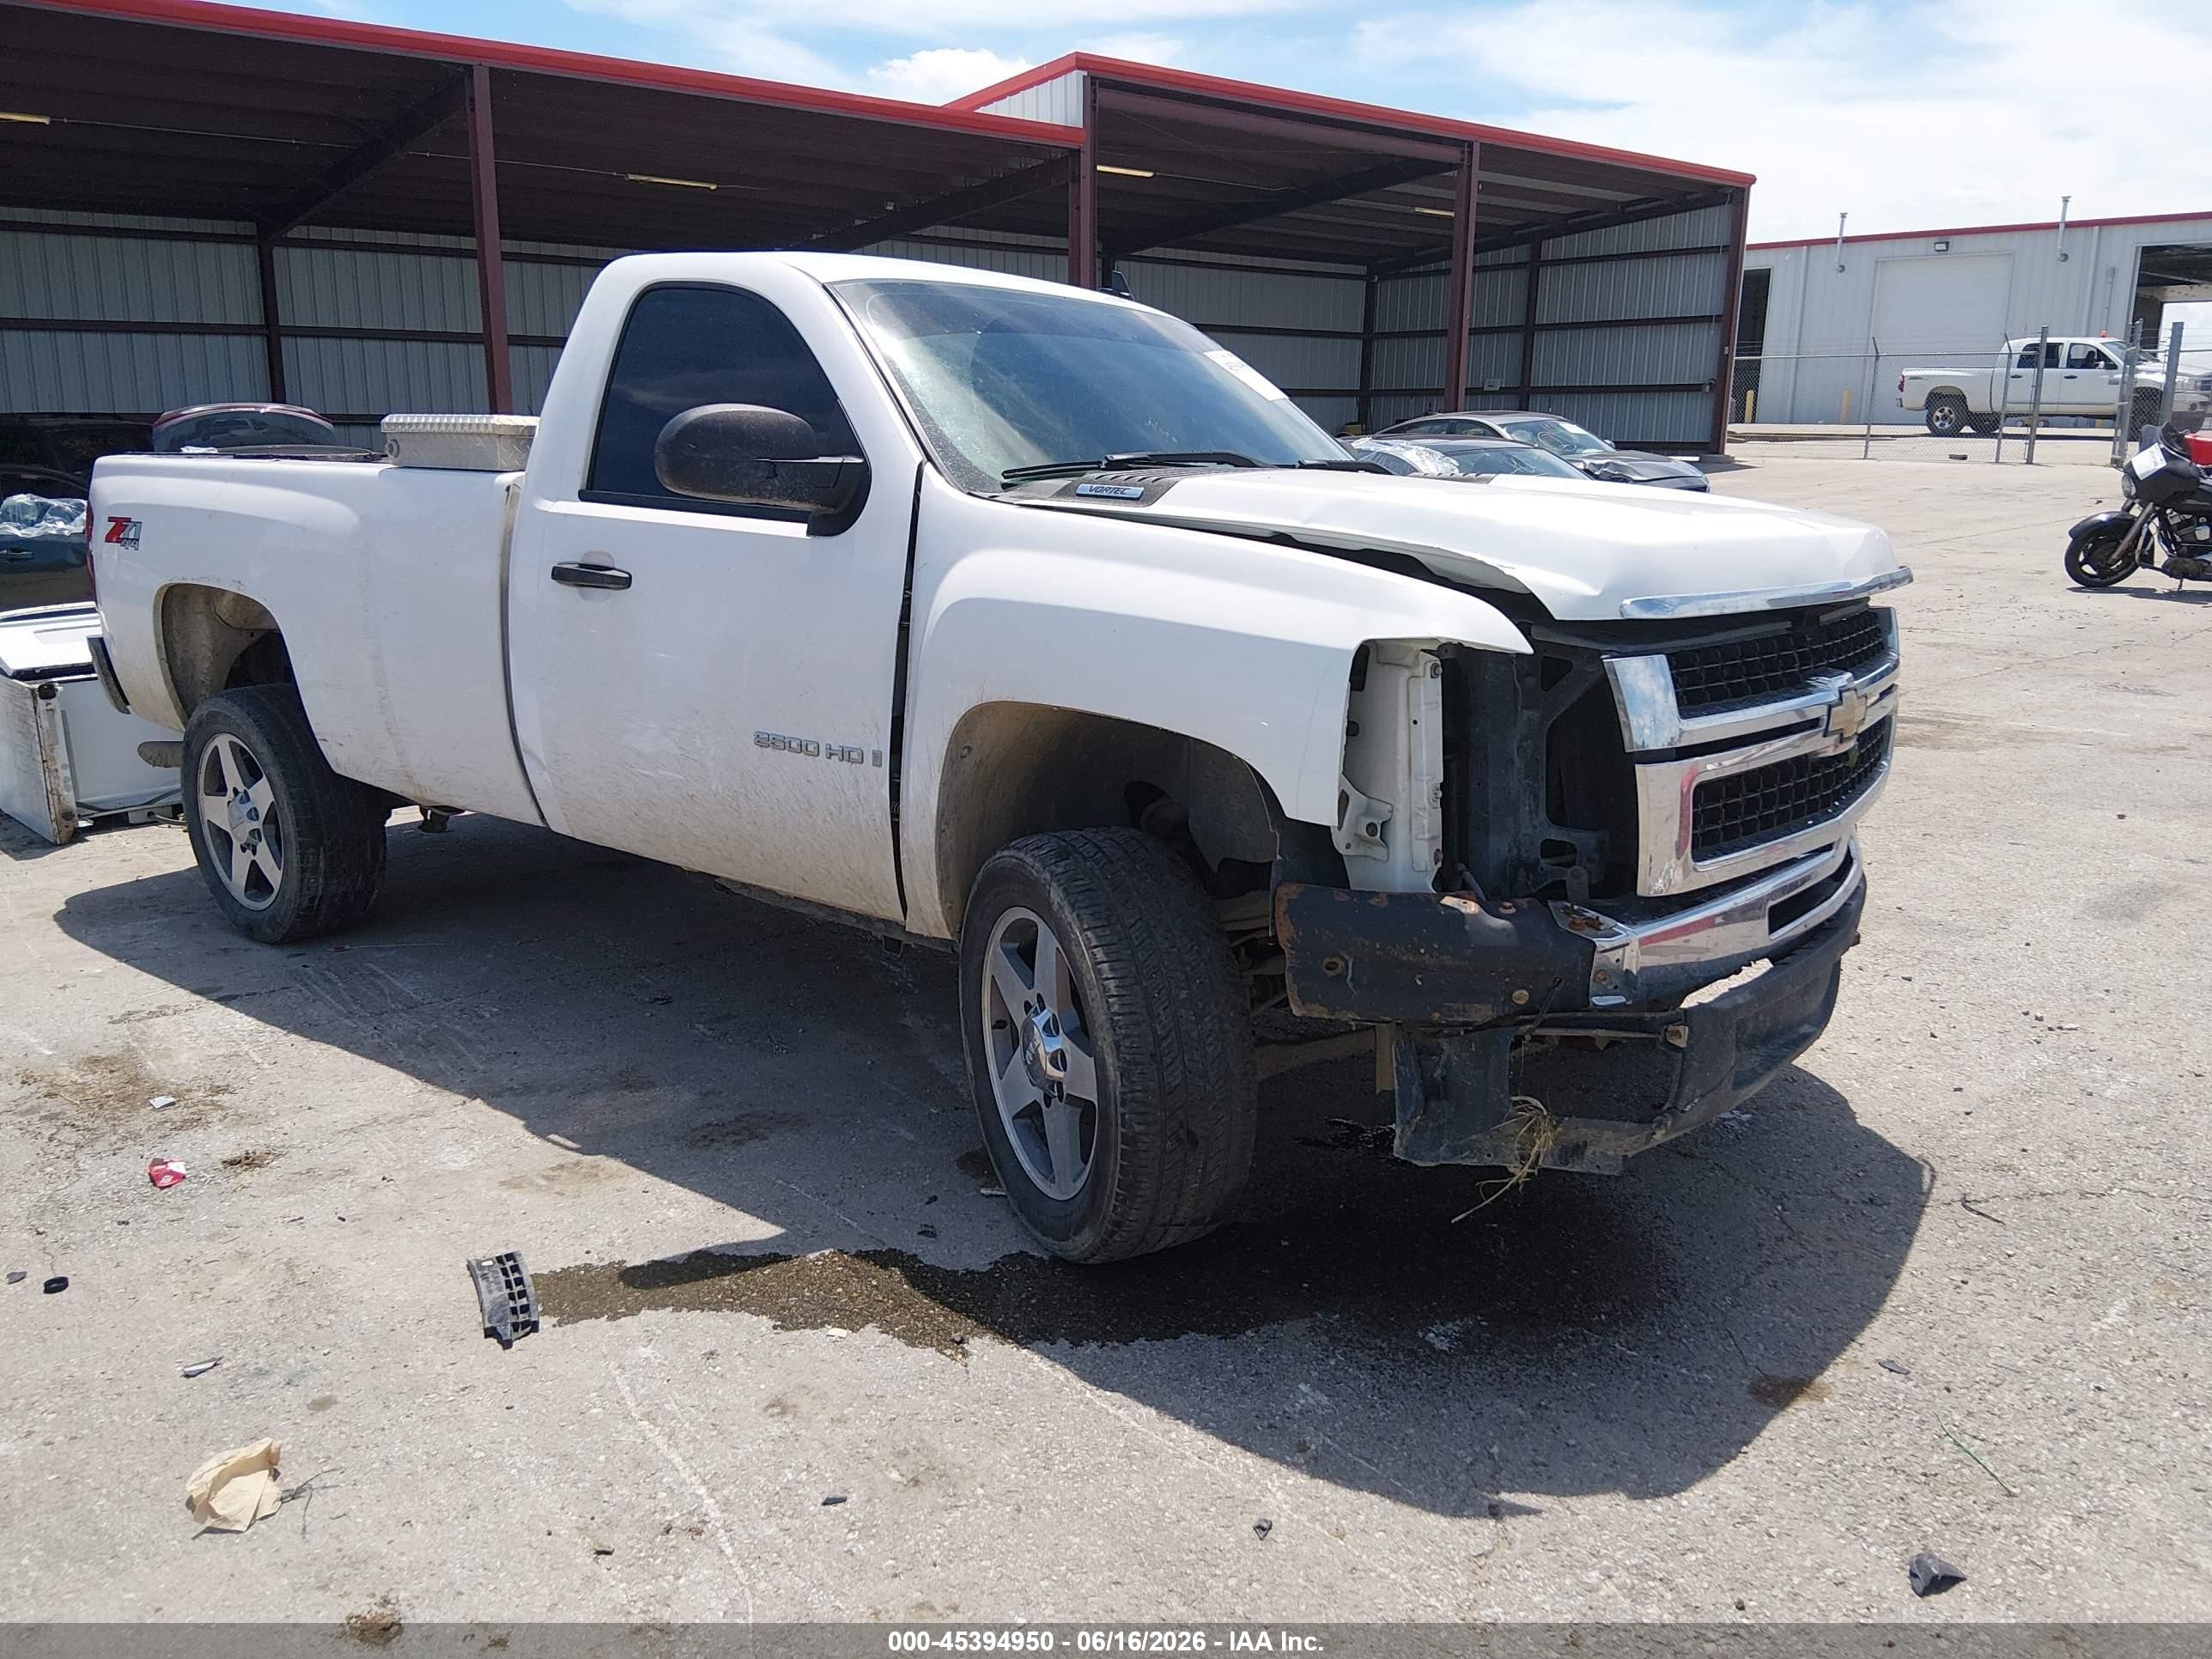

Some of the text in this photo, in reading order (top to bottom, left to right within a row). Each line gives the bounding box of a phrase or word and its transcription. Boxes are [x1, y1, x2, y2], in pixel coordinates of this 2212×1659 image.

[1089, 485, 1131, 495] VORTEC
[105, 516, 143, 544] Z71
[754, 731, 864, 764] 2500 HD
